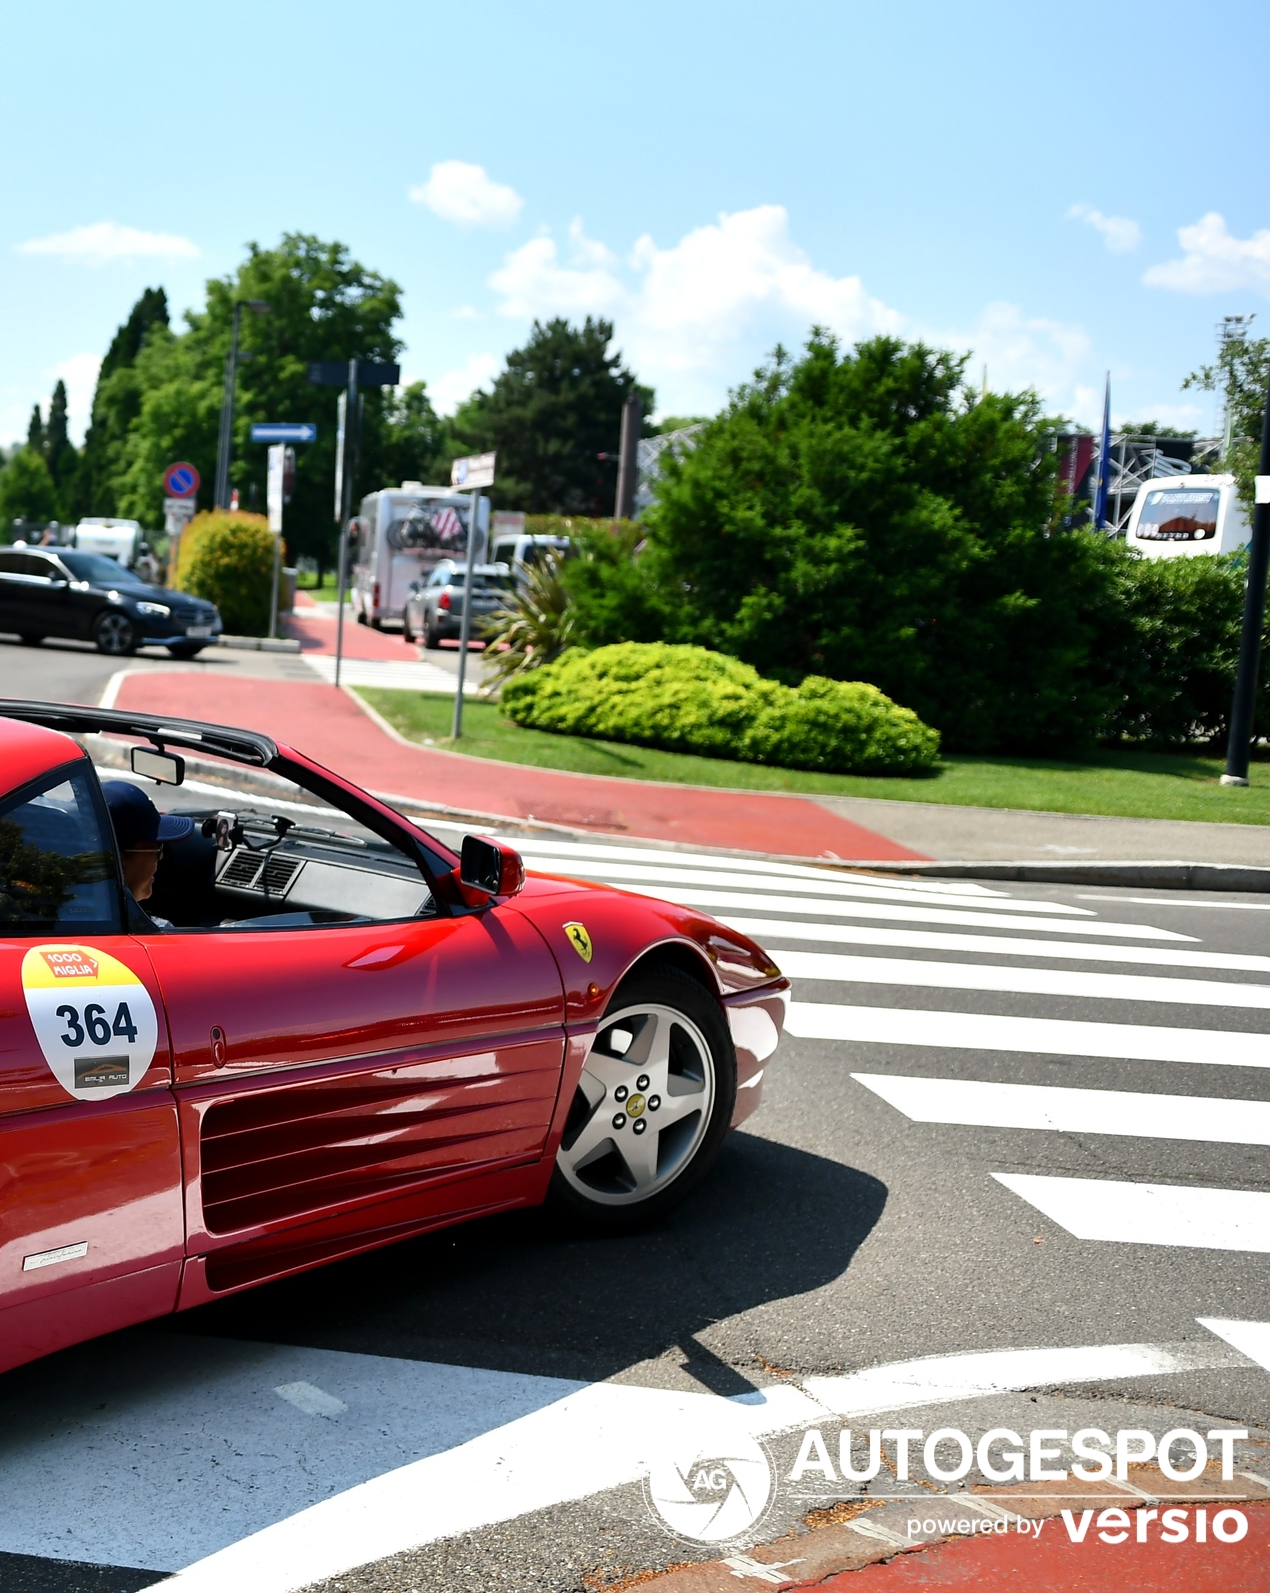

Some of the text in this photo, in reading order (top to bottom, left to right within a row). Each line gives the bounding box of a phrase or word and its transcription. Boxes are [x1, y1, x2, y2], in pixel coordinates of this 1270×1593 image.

[47, 952, 82, 963] 1000
[53, 964, 94, 976] MIGLIA
[55, 1001, 139, 1048] 364
